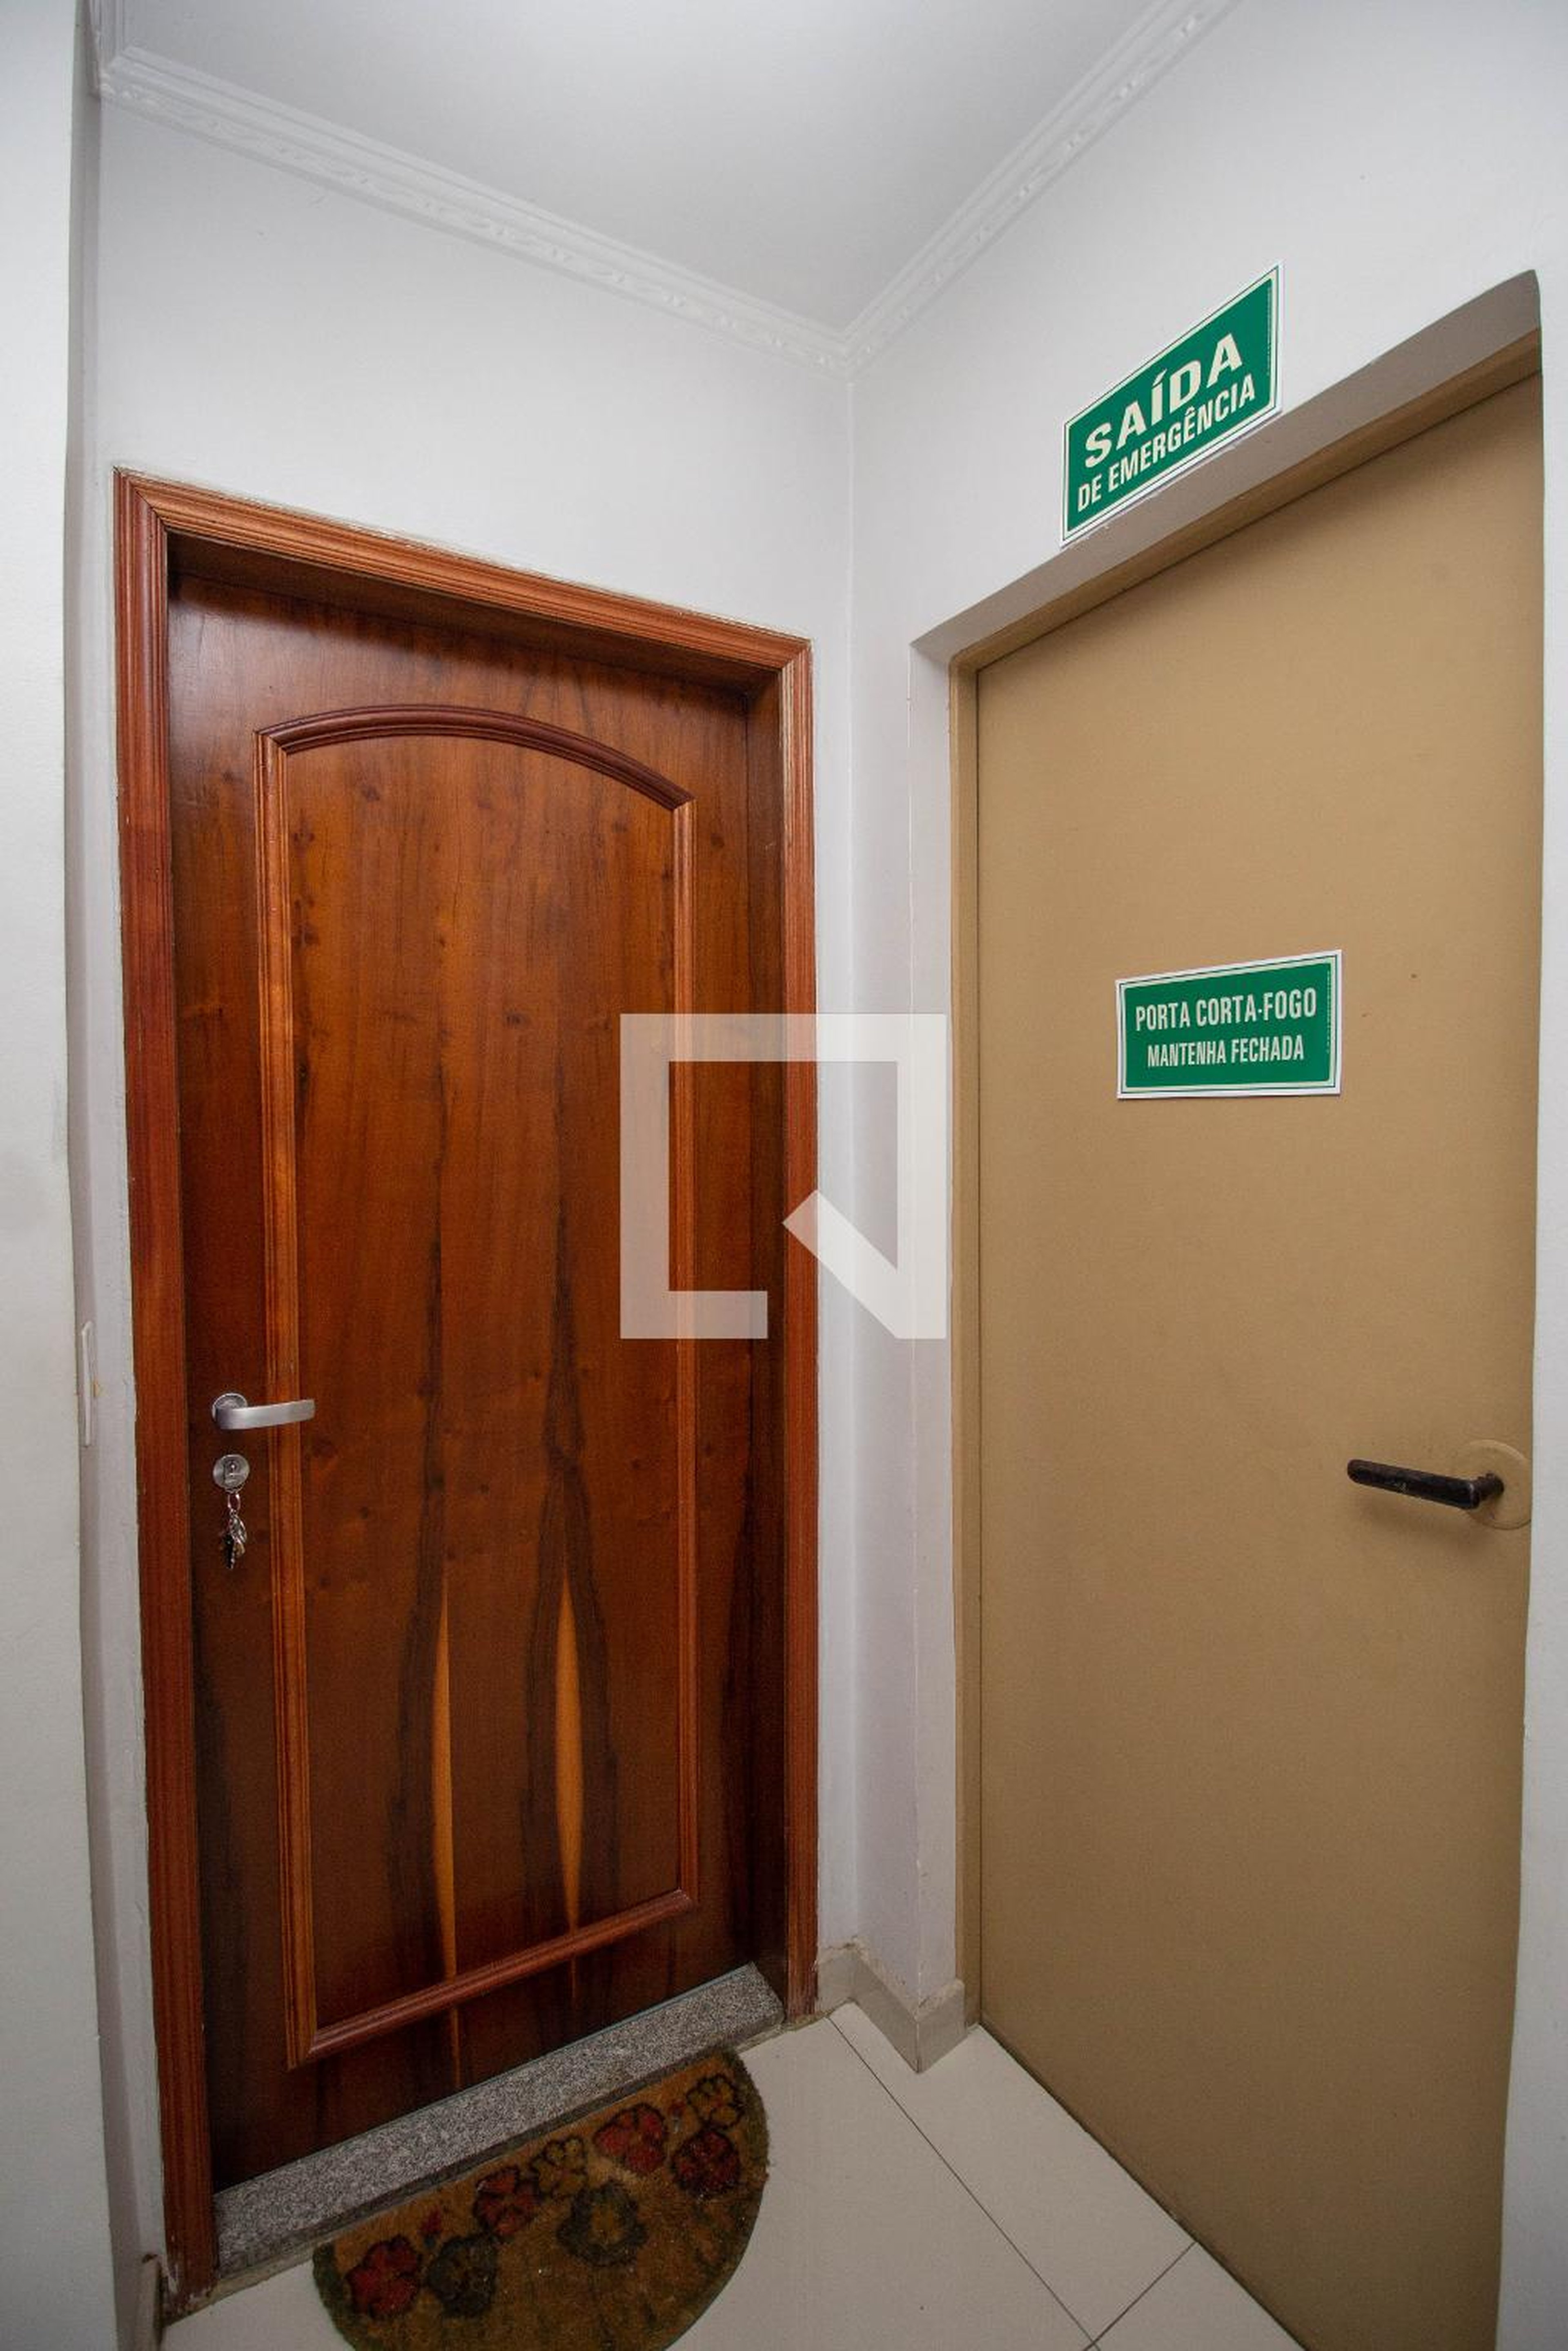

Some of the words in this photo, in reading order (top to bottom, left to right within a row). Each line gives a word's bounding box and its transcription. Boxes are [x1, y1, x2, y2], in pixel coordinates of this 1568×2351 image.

[1085, 333, 1243, 468] SAÍDA
[1077, 473, 1102, 512] DE
[1108, 373, 1255, 492] EMERGÊNCIA
[1136, 1001, 1191, 1031] PORTA
[1147, 1040, 1227, 1067] MANTENHA
[1231, 1035, 1304, 1063] FECHADA
